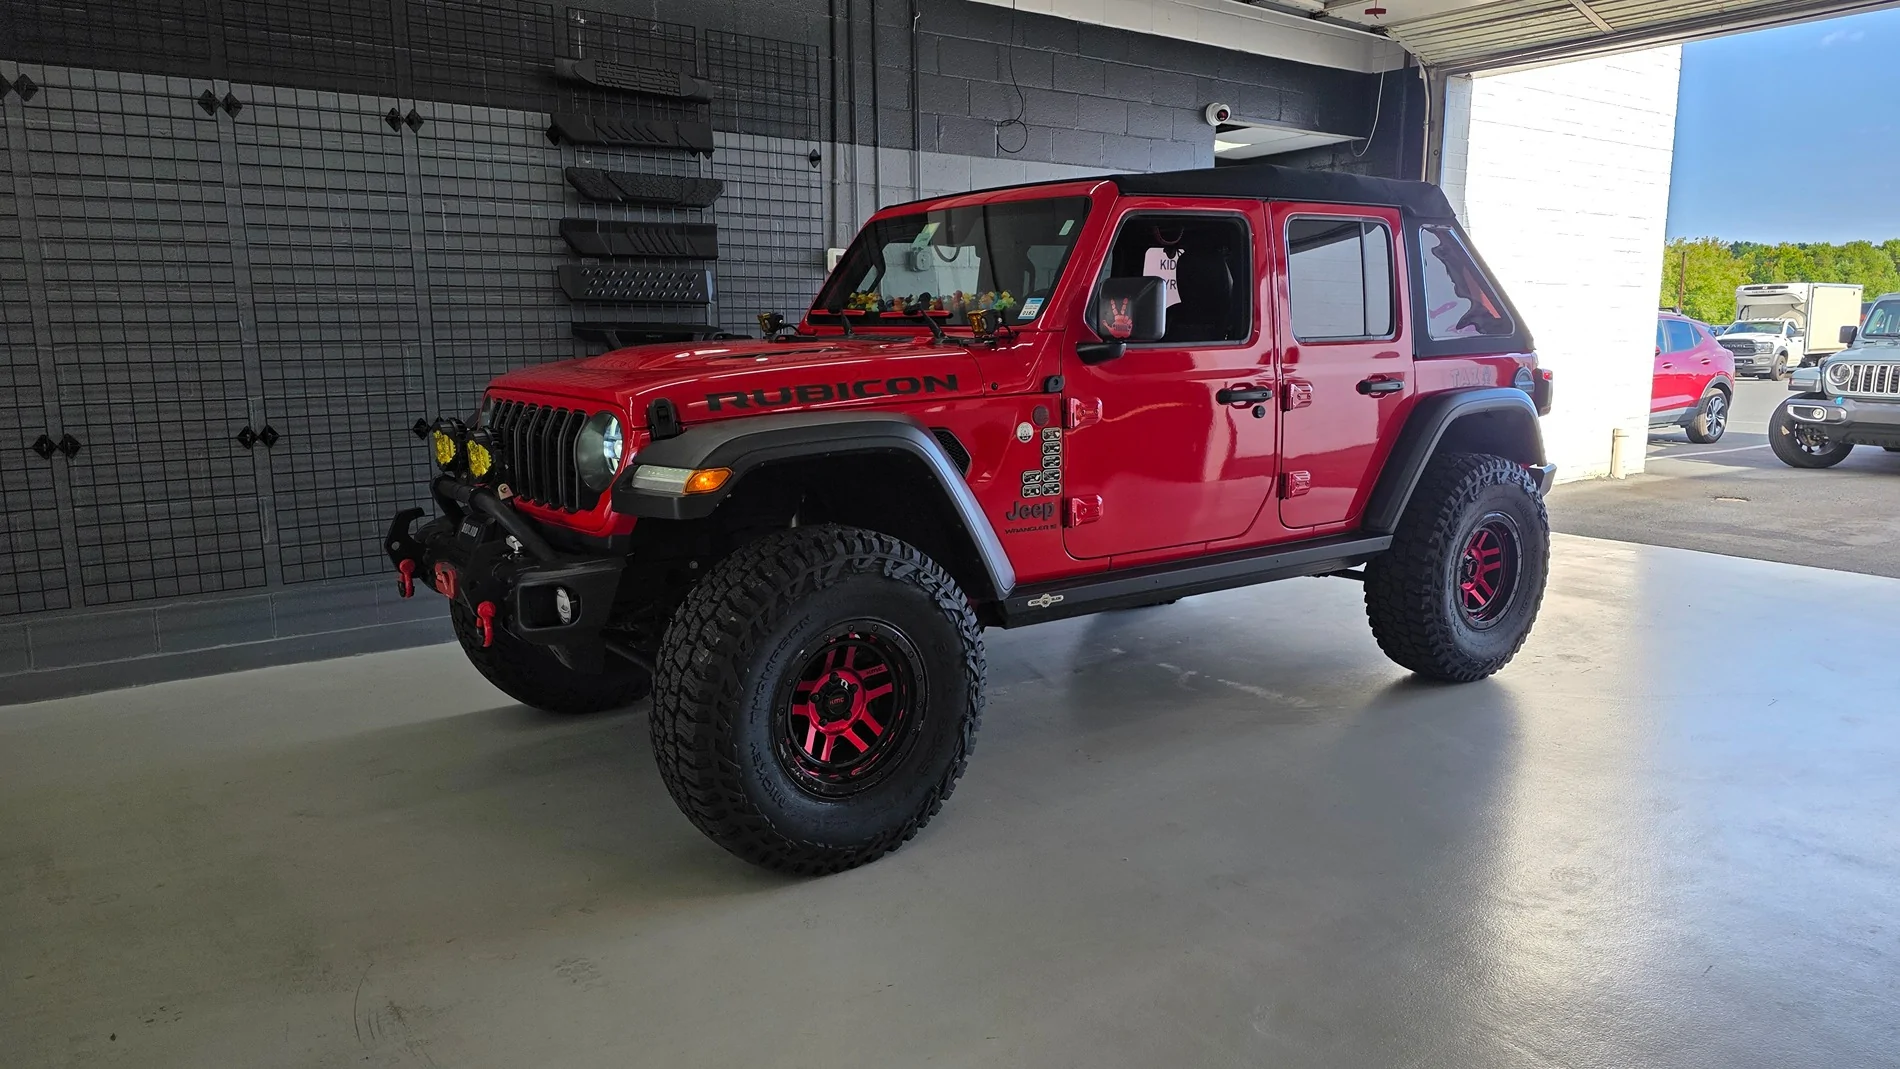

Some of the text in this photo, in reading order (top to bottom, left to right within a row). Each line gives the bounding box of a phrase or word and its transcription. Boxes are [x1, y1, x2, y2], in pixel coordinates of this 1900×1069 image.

[706, 374, 959, 412] RUBICON
[1005, 500, 1055, 521] Jeep
[1004, 524, 1049, 534] WRANGLER
